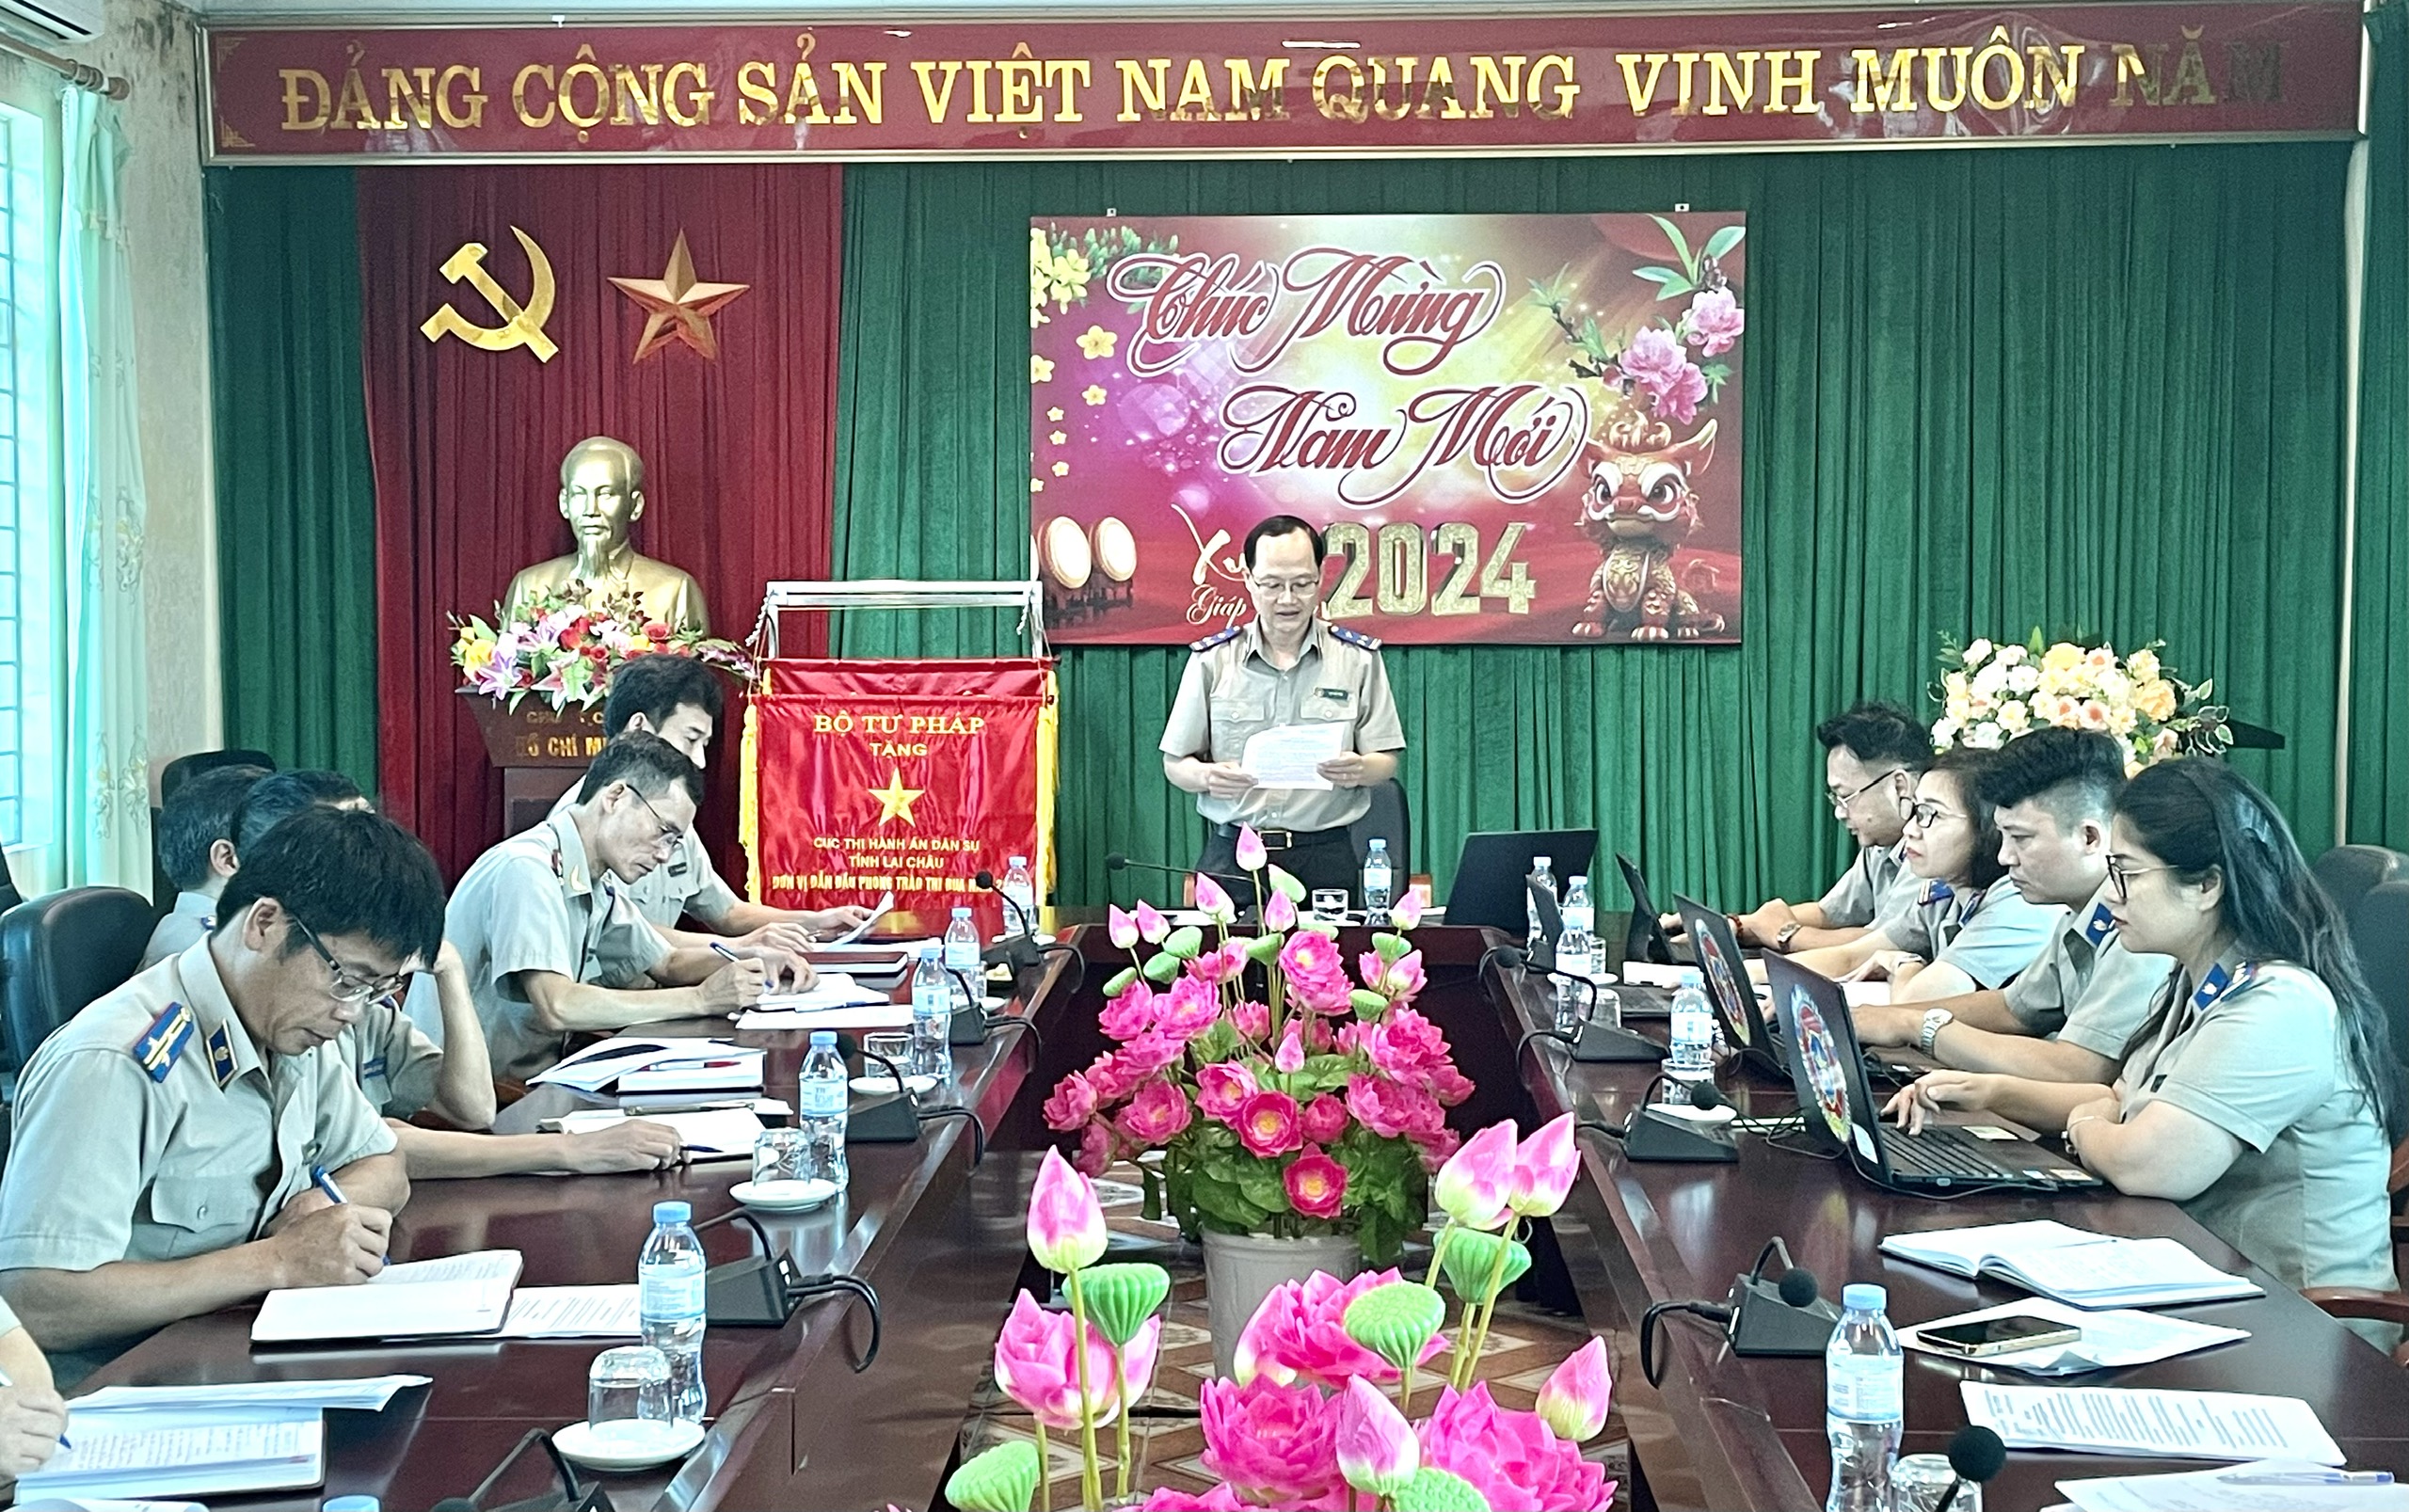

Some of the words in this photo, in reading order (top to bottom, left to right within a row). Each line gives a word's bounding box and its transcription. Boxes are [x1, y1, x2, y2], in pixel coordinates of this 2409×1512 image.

[279, 40, 487, 130] ĐẢNG
[512, 43, 715, 144] CỘNG
[738, 33, 886, 127] SẢN
[910, 41, 1092, 139] VIỆT
[1115, 56, 1289, 123] NAM
[1312, 54, 1581, 124] QUANG
[1615, 49, 1821, 117] VINH
[1850, 24, 2085, 113] MUÔN
[2109, 24, 2290, 105] NĂM
[1109, 250, 1281, 375] Chúc
[1227, 247, 1507, 377] Mừng
[1337, 383, 1590, 510] Mới
[1320, 521, 1537, 620] 2024
[1186, 583, 1247, 629] Giáp
[814, 709, 854, 738] BỘ
[862, 714, 904, 734] TƯ
[909, 711, 985, 735] PHÁP
[547, 733, 579, 757] CHÍ
[869, 740, 929, 759] TẶNG
[843, 837, 866, 851] THI
[883, 855, 903, 868] LAI
[906, 853, 945, 869] CHÂU
[858, 875, 893, 891] PHONG
[925, 876, 943, 892] THI
